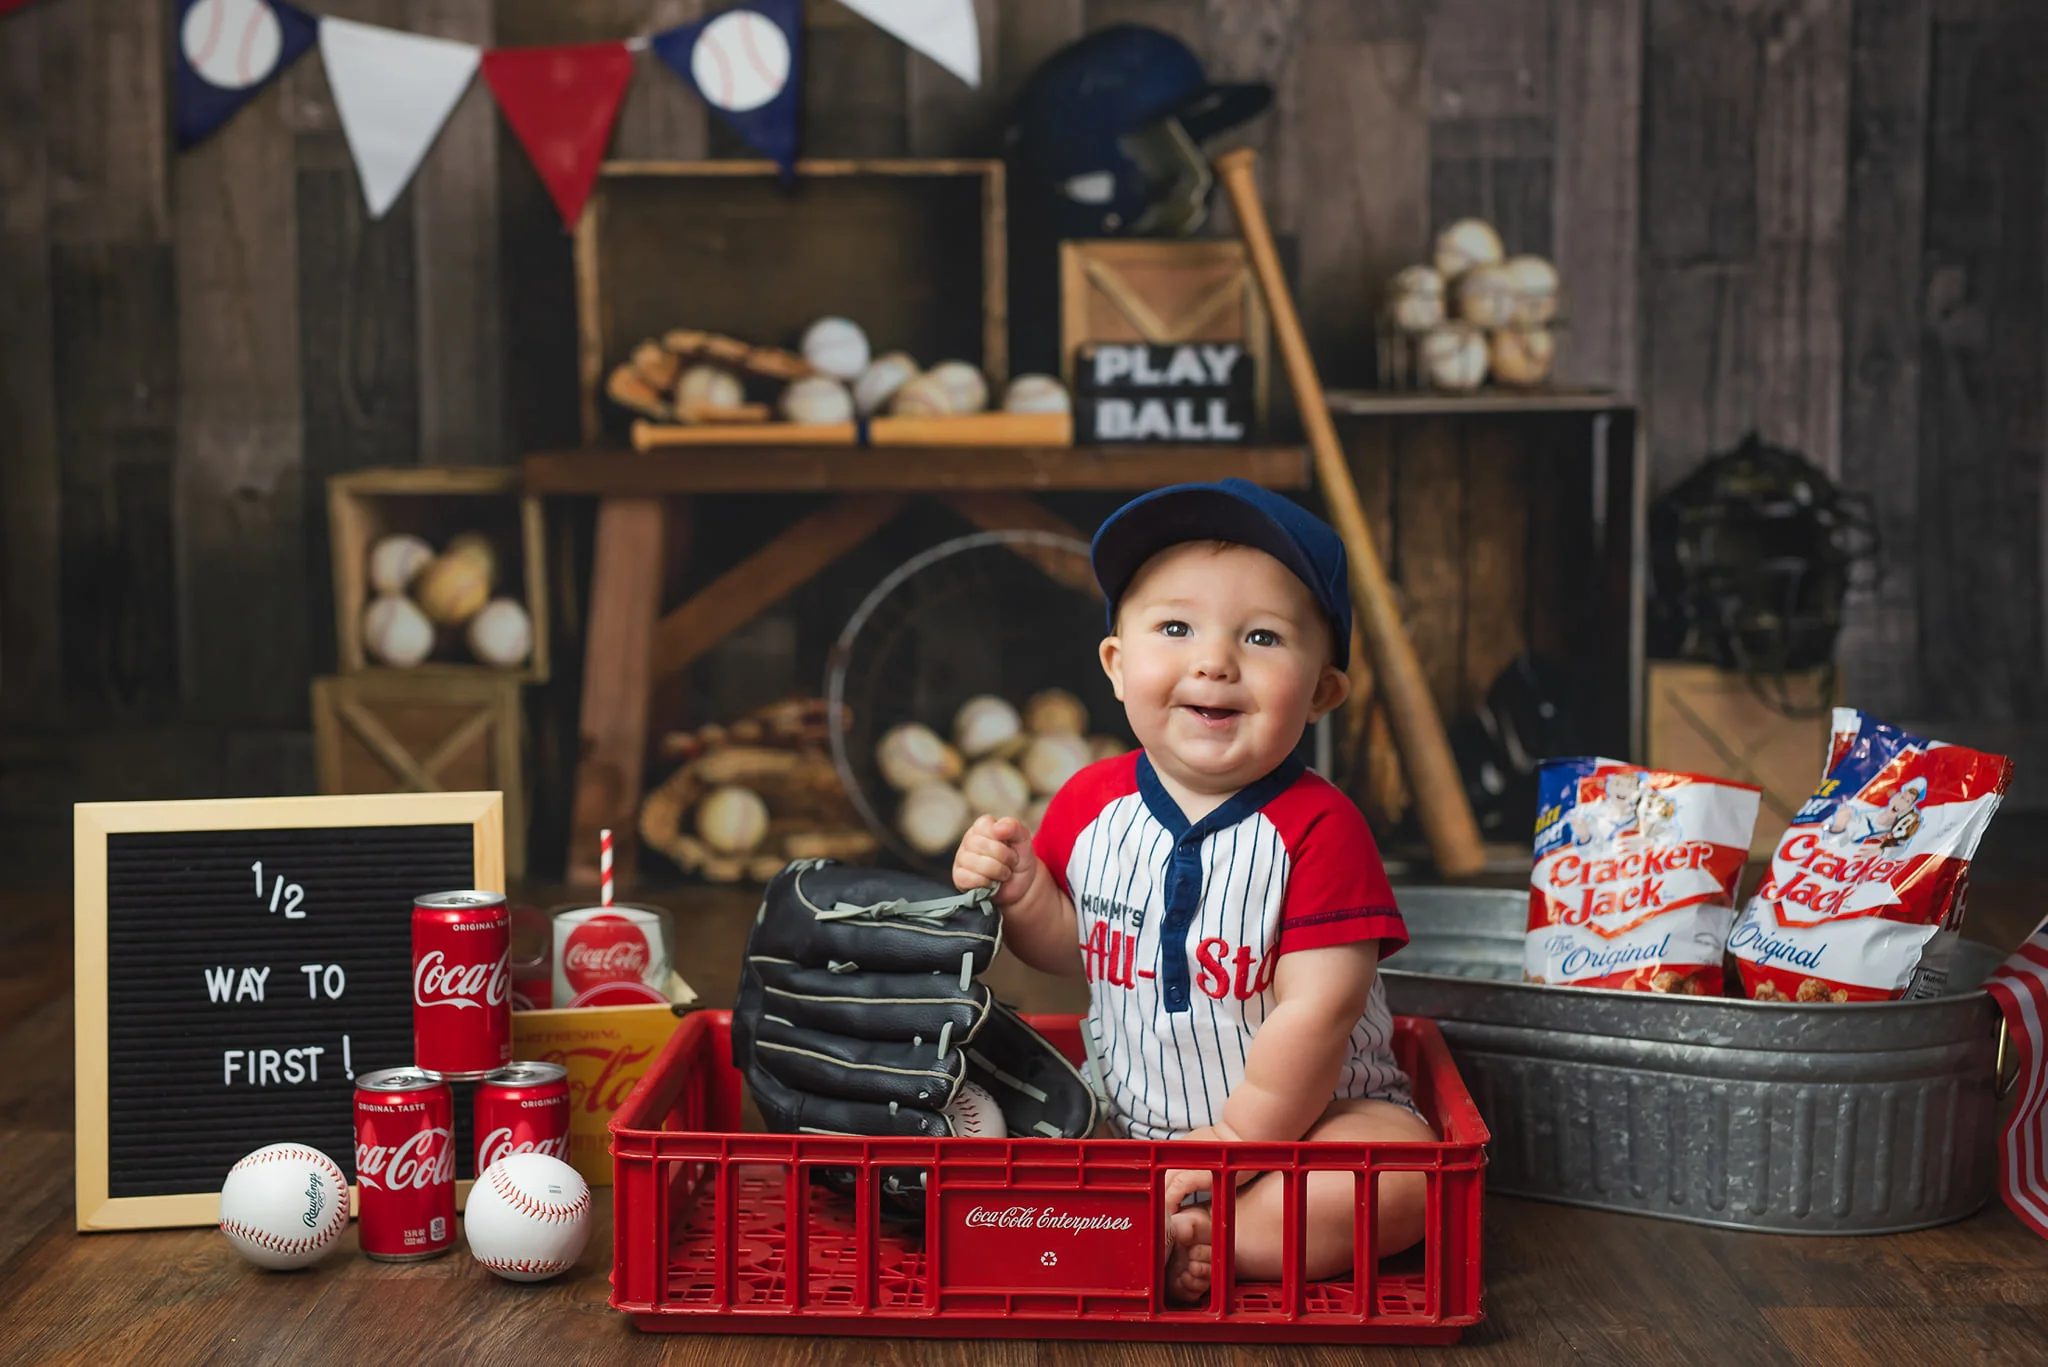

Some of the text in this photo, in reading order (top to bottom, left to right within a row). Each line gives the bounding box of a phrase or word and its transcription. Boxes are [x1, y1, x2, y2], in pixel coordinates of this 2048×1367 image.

[1093, 344, 1241, 386] PLAY
[1094, 397, 1245, 440] BALL
[1549, 841, 1714, 888] Cracker
[1778, 832, 1912, 884] Cracker
[251, 860, 307, 919] 1/2
[1081, 892, 1144, 928] MOMMY'S
[1563, 877, 1666, 927] Jack
[1760, 870, 1858, 916] Jack
[452, 922, 495, 932] ORIGINAL
[1729, 922, 1828, 969] Original
[1561, 932, 1672, 978] Original
[204, 964, 346, 1003] WAY TO
[223, 1046, 325, 1087] FIRST
[358, 1102, 426, 1113] ORIGINAL TASTE
[302, 1171, 325, 1228] Rawlings
[965, 1206, 1133, 1237] Coca-Cola Enterprises
